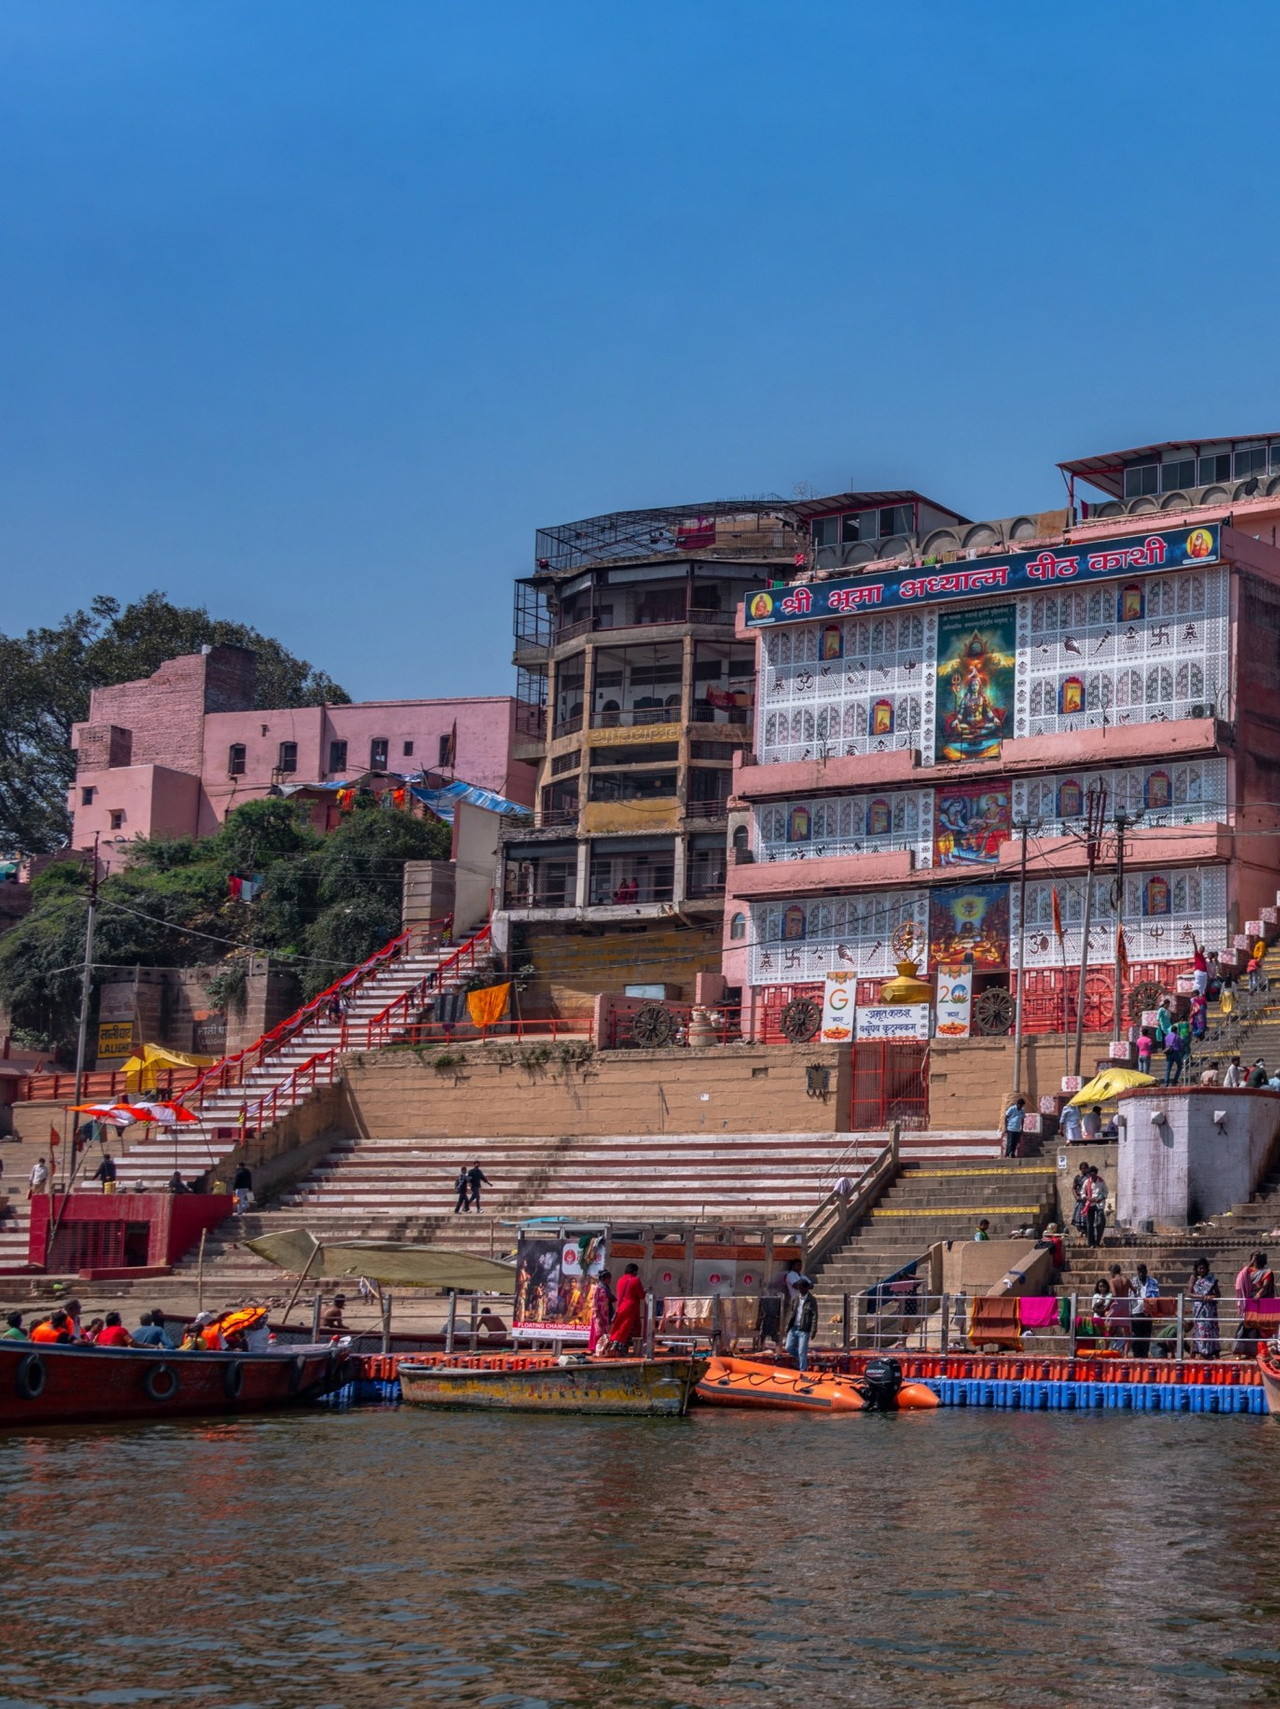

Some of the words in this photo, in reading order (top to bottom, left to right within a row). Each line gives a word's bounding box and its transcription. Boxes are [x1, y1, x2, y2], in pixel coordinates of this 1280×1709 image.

[781, 587, 813, 616] श्री
[828, 583, 884, 613] भूमा
[899, 565, 1010, 599] अध्यात्म
[1026, 551, 1080, 580] पीठ
[1088, 535, 1167, 572] काशी
